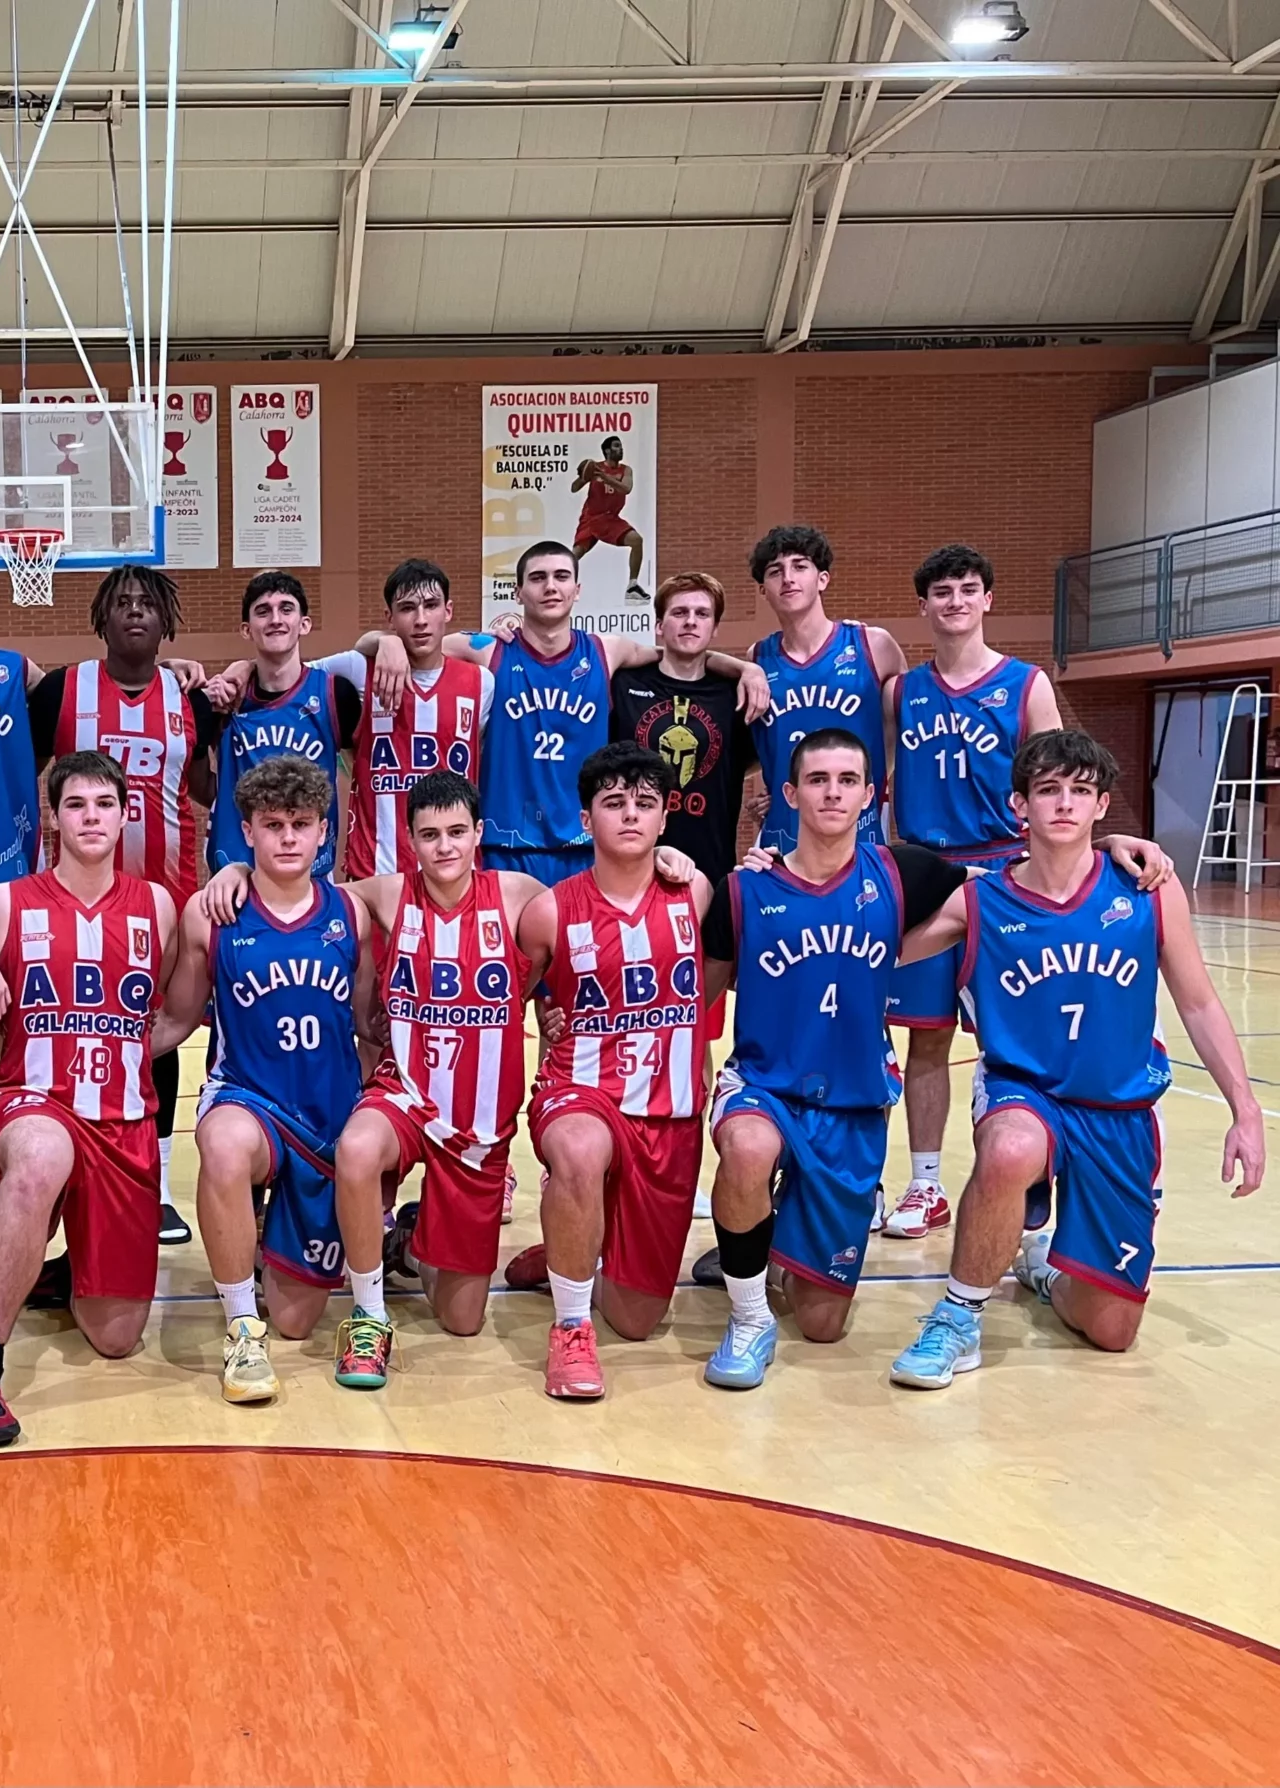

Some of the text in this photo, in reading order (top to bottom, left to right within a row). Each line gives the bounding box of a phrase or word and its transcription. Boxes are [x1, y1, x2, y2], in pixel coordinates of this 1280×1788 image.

[239, 393, 285, 408] ABQ
[490, 391, 649, 406] ASOCIACION BALONCESTO
[239, 410, 285, 421] Calahorra
[508, 412, 632, 438] QUINTILIANO
[554, 444, 568, 456] DE
[496, 460, 568, 472] BALONCESTO
[259, 504, 296, 512] CAMPEÓN
[493, 592, 508, 600] San
[599, 614, 650, 632] OPTICA
[505, 688, 596, 724] CLAVIJO
[100, 735, 164, 776] TB
[233, 725, 324, 761] CLAVIJO
[534, 732, 564, 760] 22
[934, 749, 966, 779] 11
[667, 790, 706, 816] BQ
[760, 904, 786, 916] vive
[232, 938, 256, 946] vive
[1000, 922, 1026, 934] vive
[758, 924, 887, 978] CLAVIJO
[232, 959, 350, 1008] CLAVIJO
[1000, 943, 1139, 997] CLAVIJO
[388, 996, 508, 1027] CALAHORRA
[820, 984, 838, 1018] 4
[24, 1011, 146, 1041] CALAHORRA
[276, 1015, 320, 1051] 30
[571, 1003, 696, 1034] CALAHORRA
[1061, 1004, 1084, 1040] 7
[67, 1045, 112, 1086] 48
[423, 1033, 464, 1070] 57
[616, 1038, 662, 1078] 54
[304, 1240, 340, 1270] 30
[1115, 1242, 1139, 1270] 7
